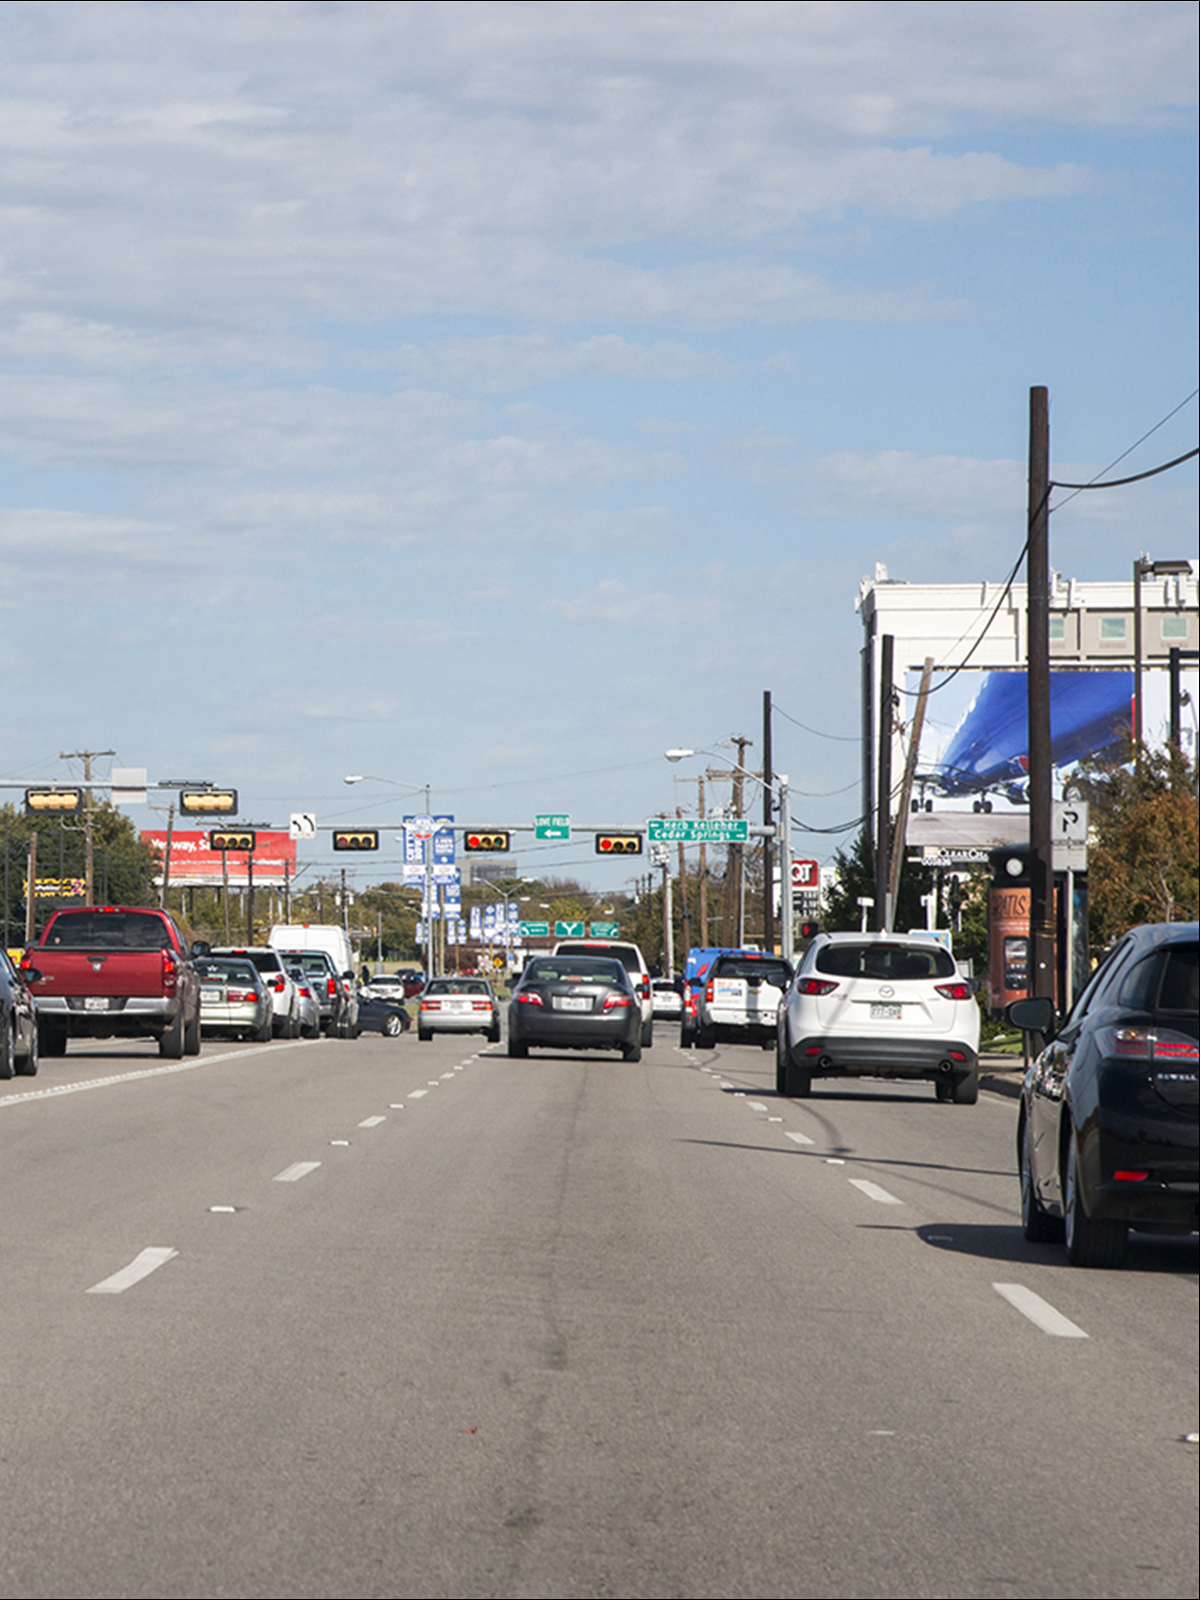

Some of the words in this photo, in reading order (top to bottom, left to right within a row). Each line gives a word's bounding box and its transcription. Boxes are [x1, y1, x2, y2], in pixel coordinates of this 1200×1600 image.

[552, 817, 570, 827] FIELD
[663, 820, 689, 830] Herb
[694, 820, 738, 830] Kelleher
[654, 830, 686, 839] Cedar
[690, 830, 731, 841] Springs
[151, 838, 197, 853] Yeway,
[791, 863, 814, 883] QT
